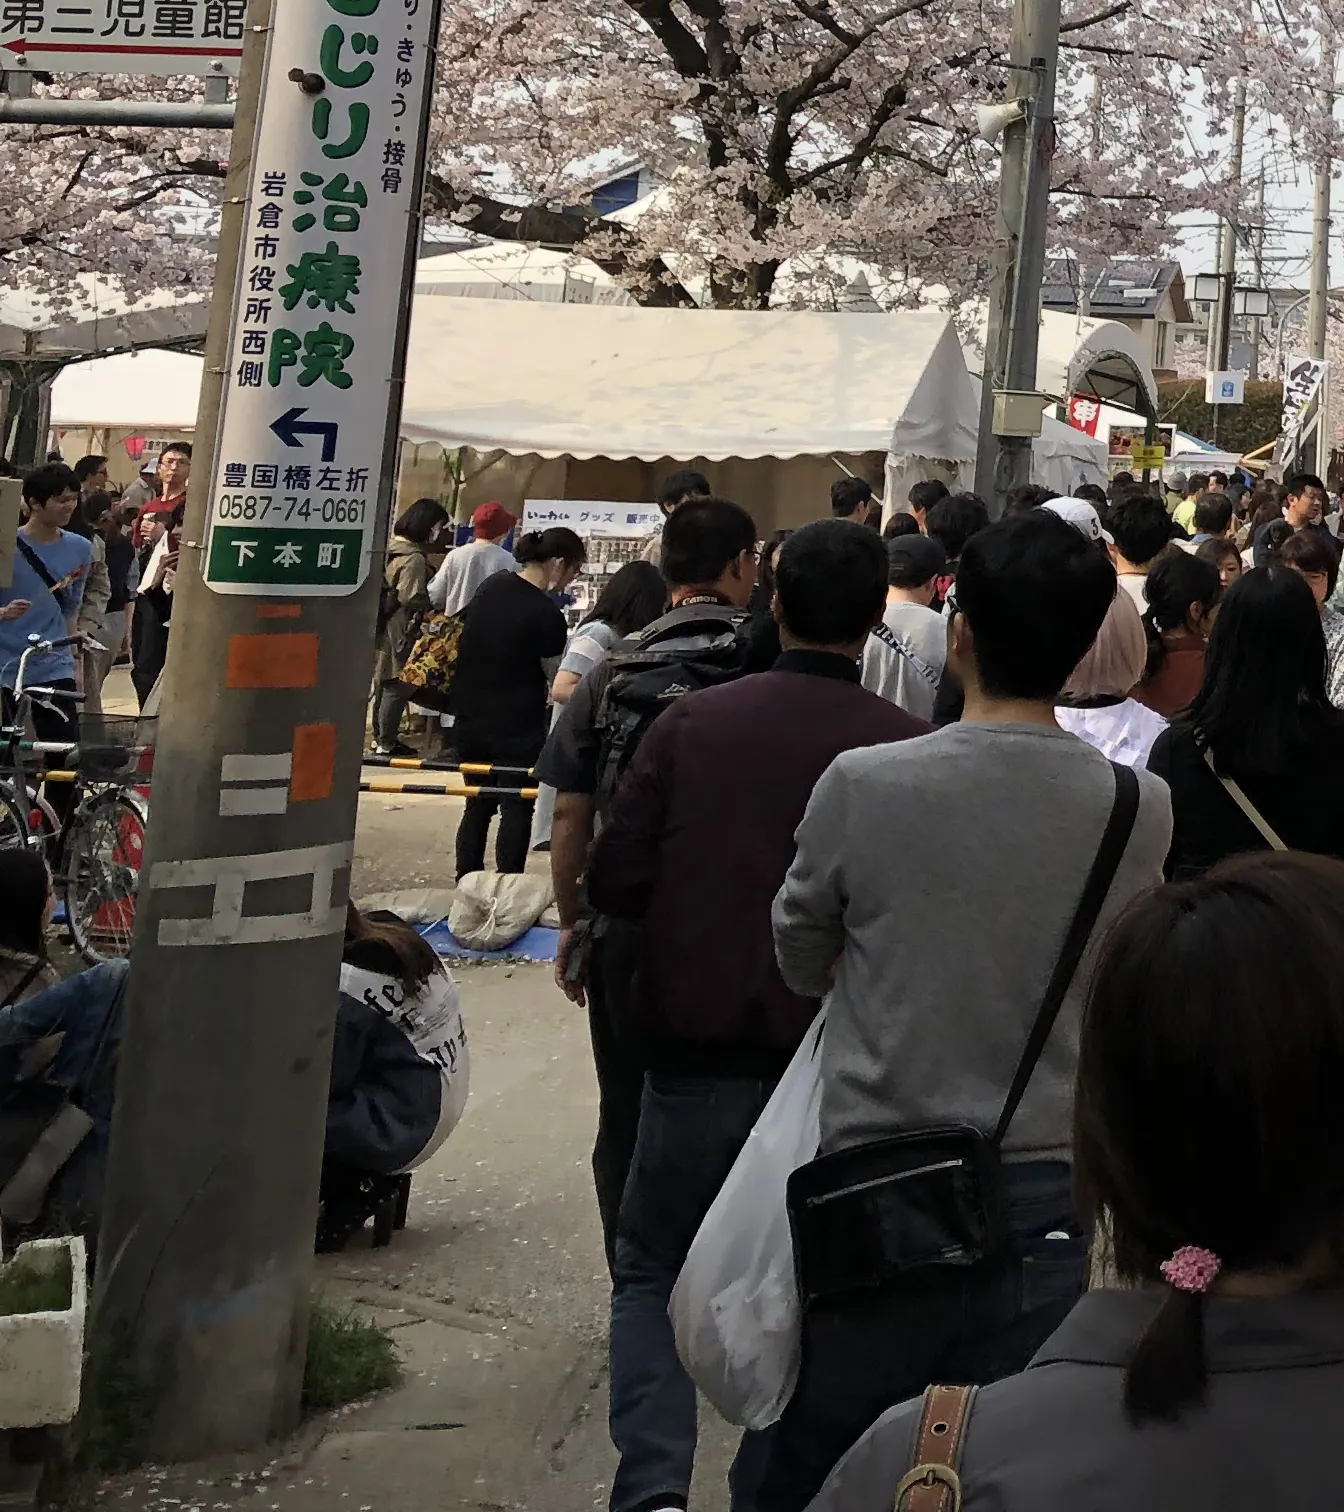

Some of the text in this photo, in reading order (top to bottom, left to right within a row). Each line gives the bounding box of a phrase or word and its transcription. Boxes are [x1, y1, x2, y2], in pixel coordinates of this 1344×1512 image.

[236, 170, 287, 388] 岩倉市役所西側
[222, 462, 370, 493] 豊国橋左折
[219, 494, 366, 524] 0587-74-0661
[579, 511, 615, 523] グッズ
[626, 513, 661, 524] 販売中
[230, 541, 346, 570] 下本町
[682, 595, 718, 606] Canon
